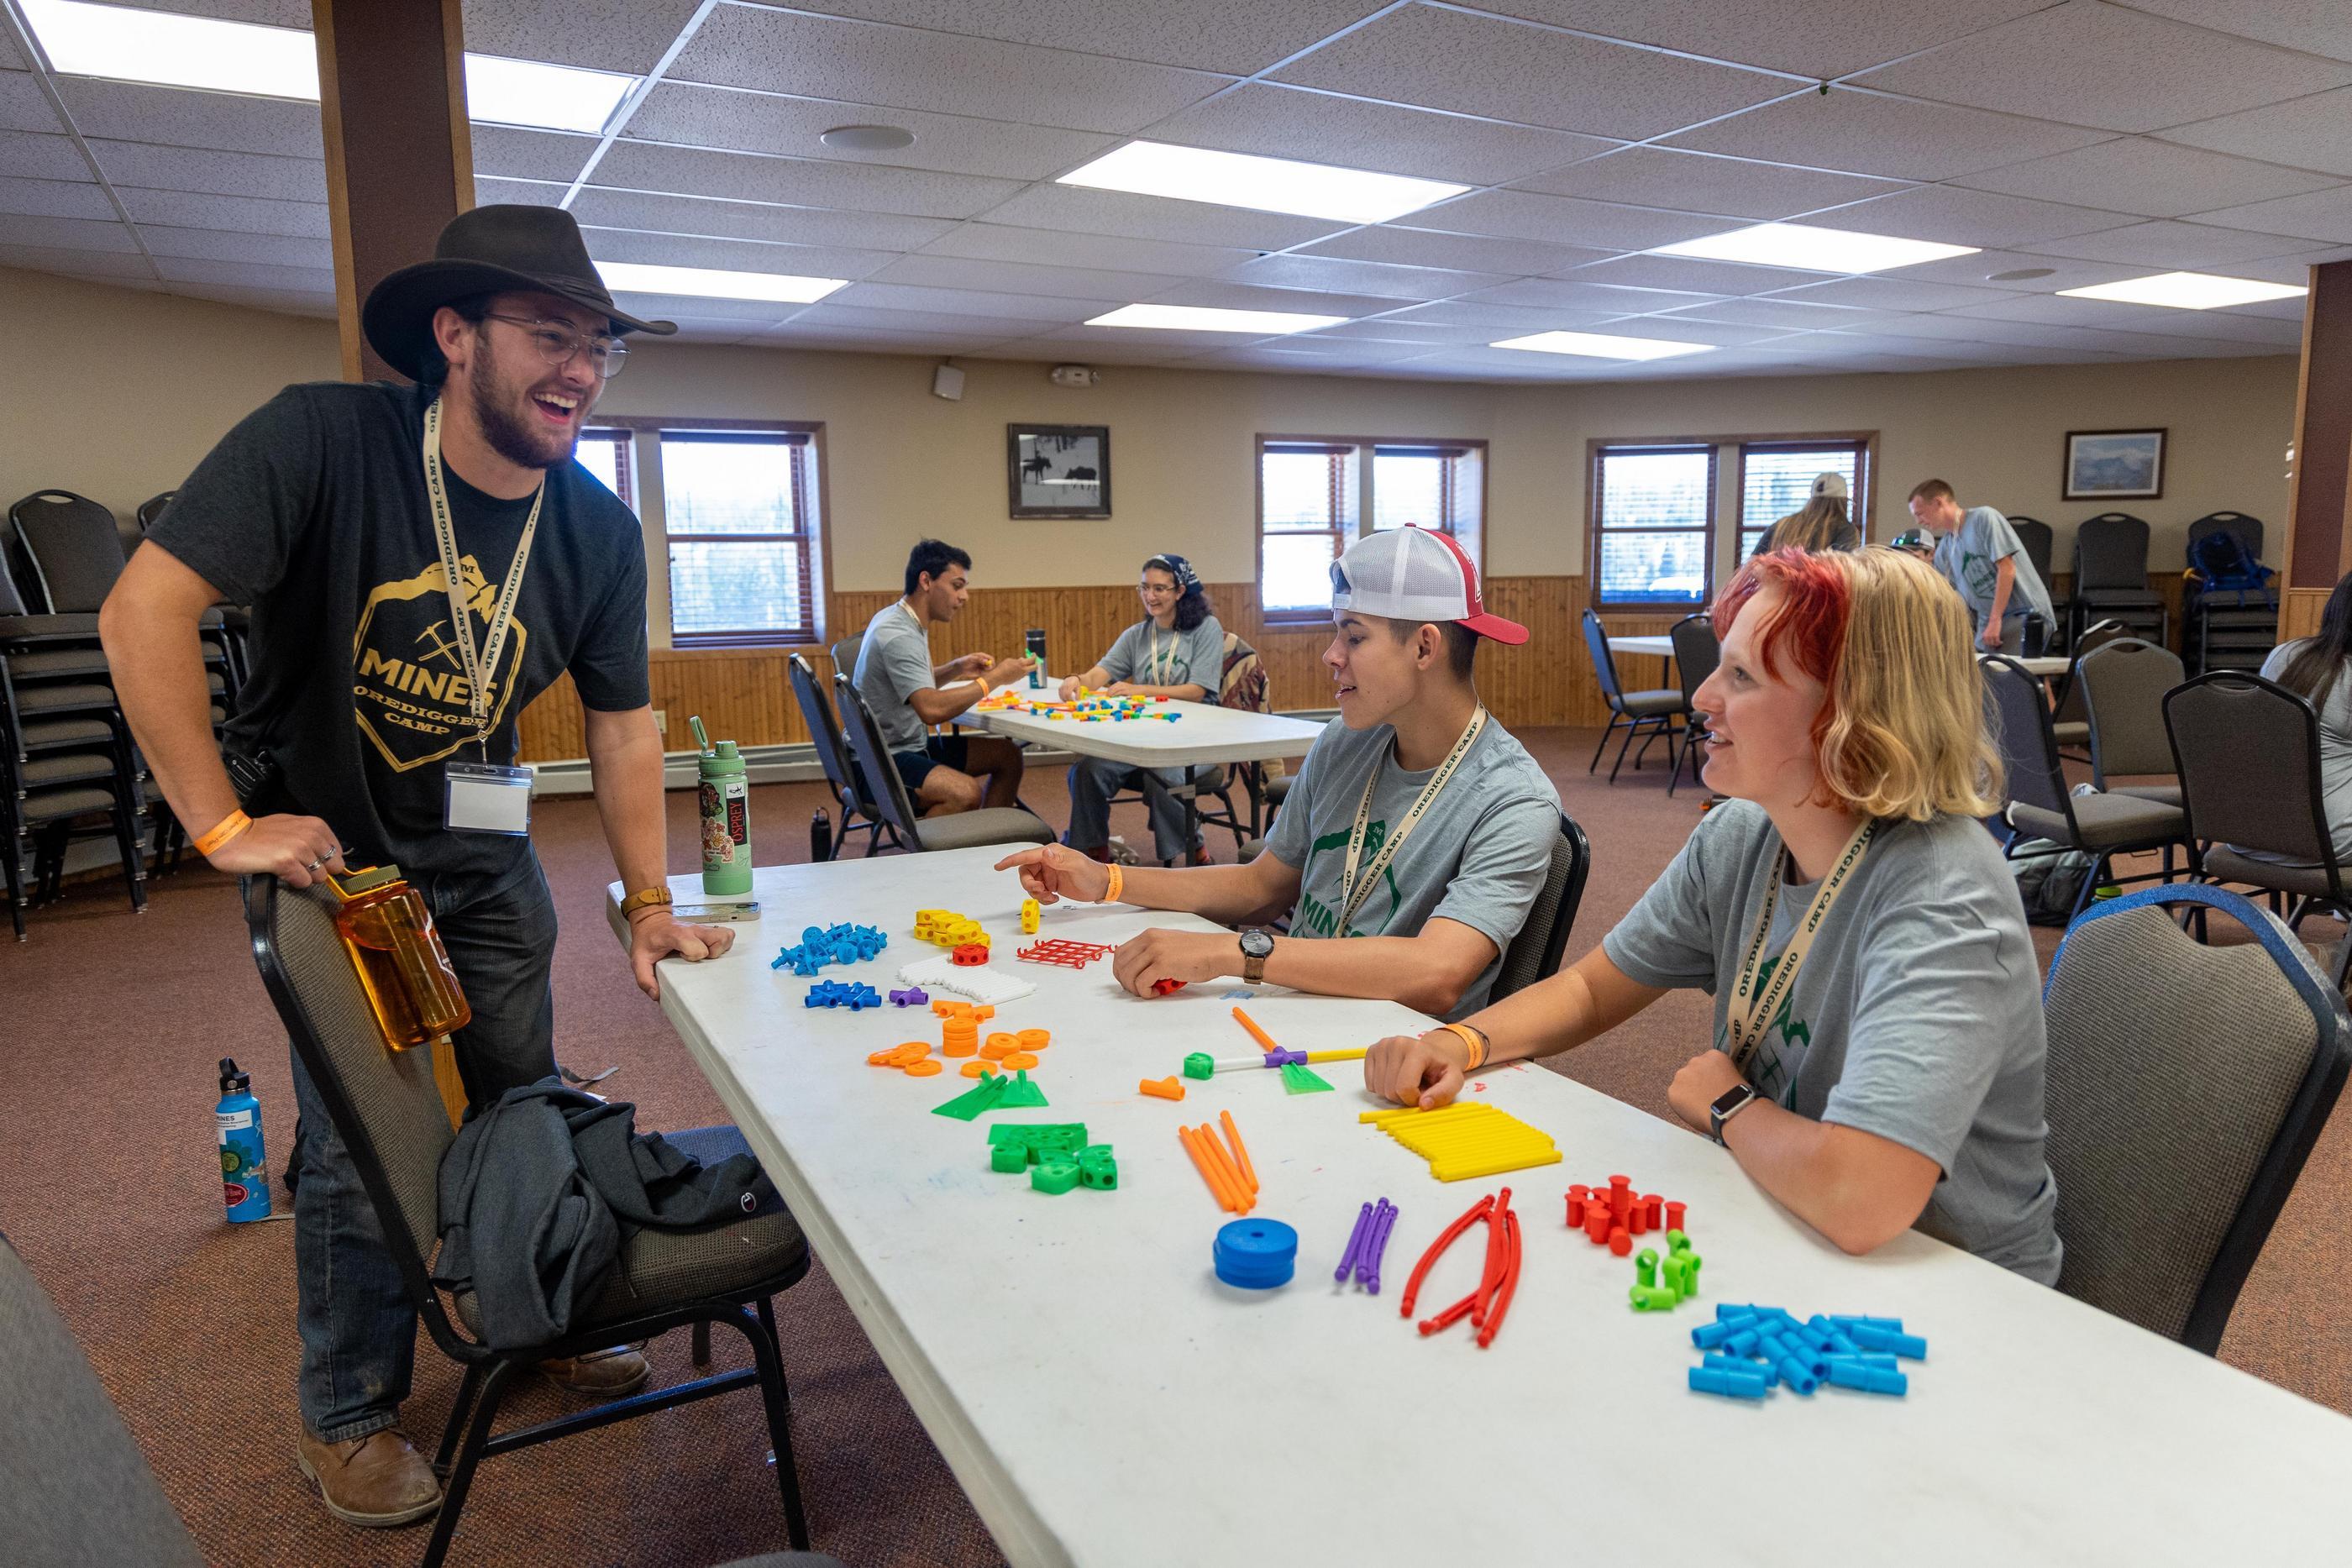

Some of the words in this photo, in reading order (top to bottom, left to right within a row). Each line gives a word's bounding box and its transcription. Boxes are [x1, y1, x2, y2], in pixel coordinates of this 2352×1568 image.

[428, 454, 441, 496] CAMP
[436, 499, 458, 585] OREDIGGER
[497, 550, 524, 628] OREDIGGER
[456, 606, 470, 645] CAMP
[485, 632, 501, 669] CAMP
[358, 647, 497, 709] MINES
[465, 649, 481, 716] EDIGGER
[354, 685, 488, 729] OREDIGGER
[383, 712, 450, 736] CAMP
[1412, 754, 1458, 817] OREDIGGER
[1457, 721, 1478, 753] CAMP
[730, 802, 744, 842] OSPREY
[1352, 822, 1362, 853] CAMP
[1382, 831, 1404, 862] CAMP
[1302, 892, 1367, 938] MIN
[1808, 890, 1831, 933] CAMP
[1739, 896, 1774, 997] OREDIGGER
[1753, 952, 1798, 1031] OREDIGGER
